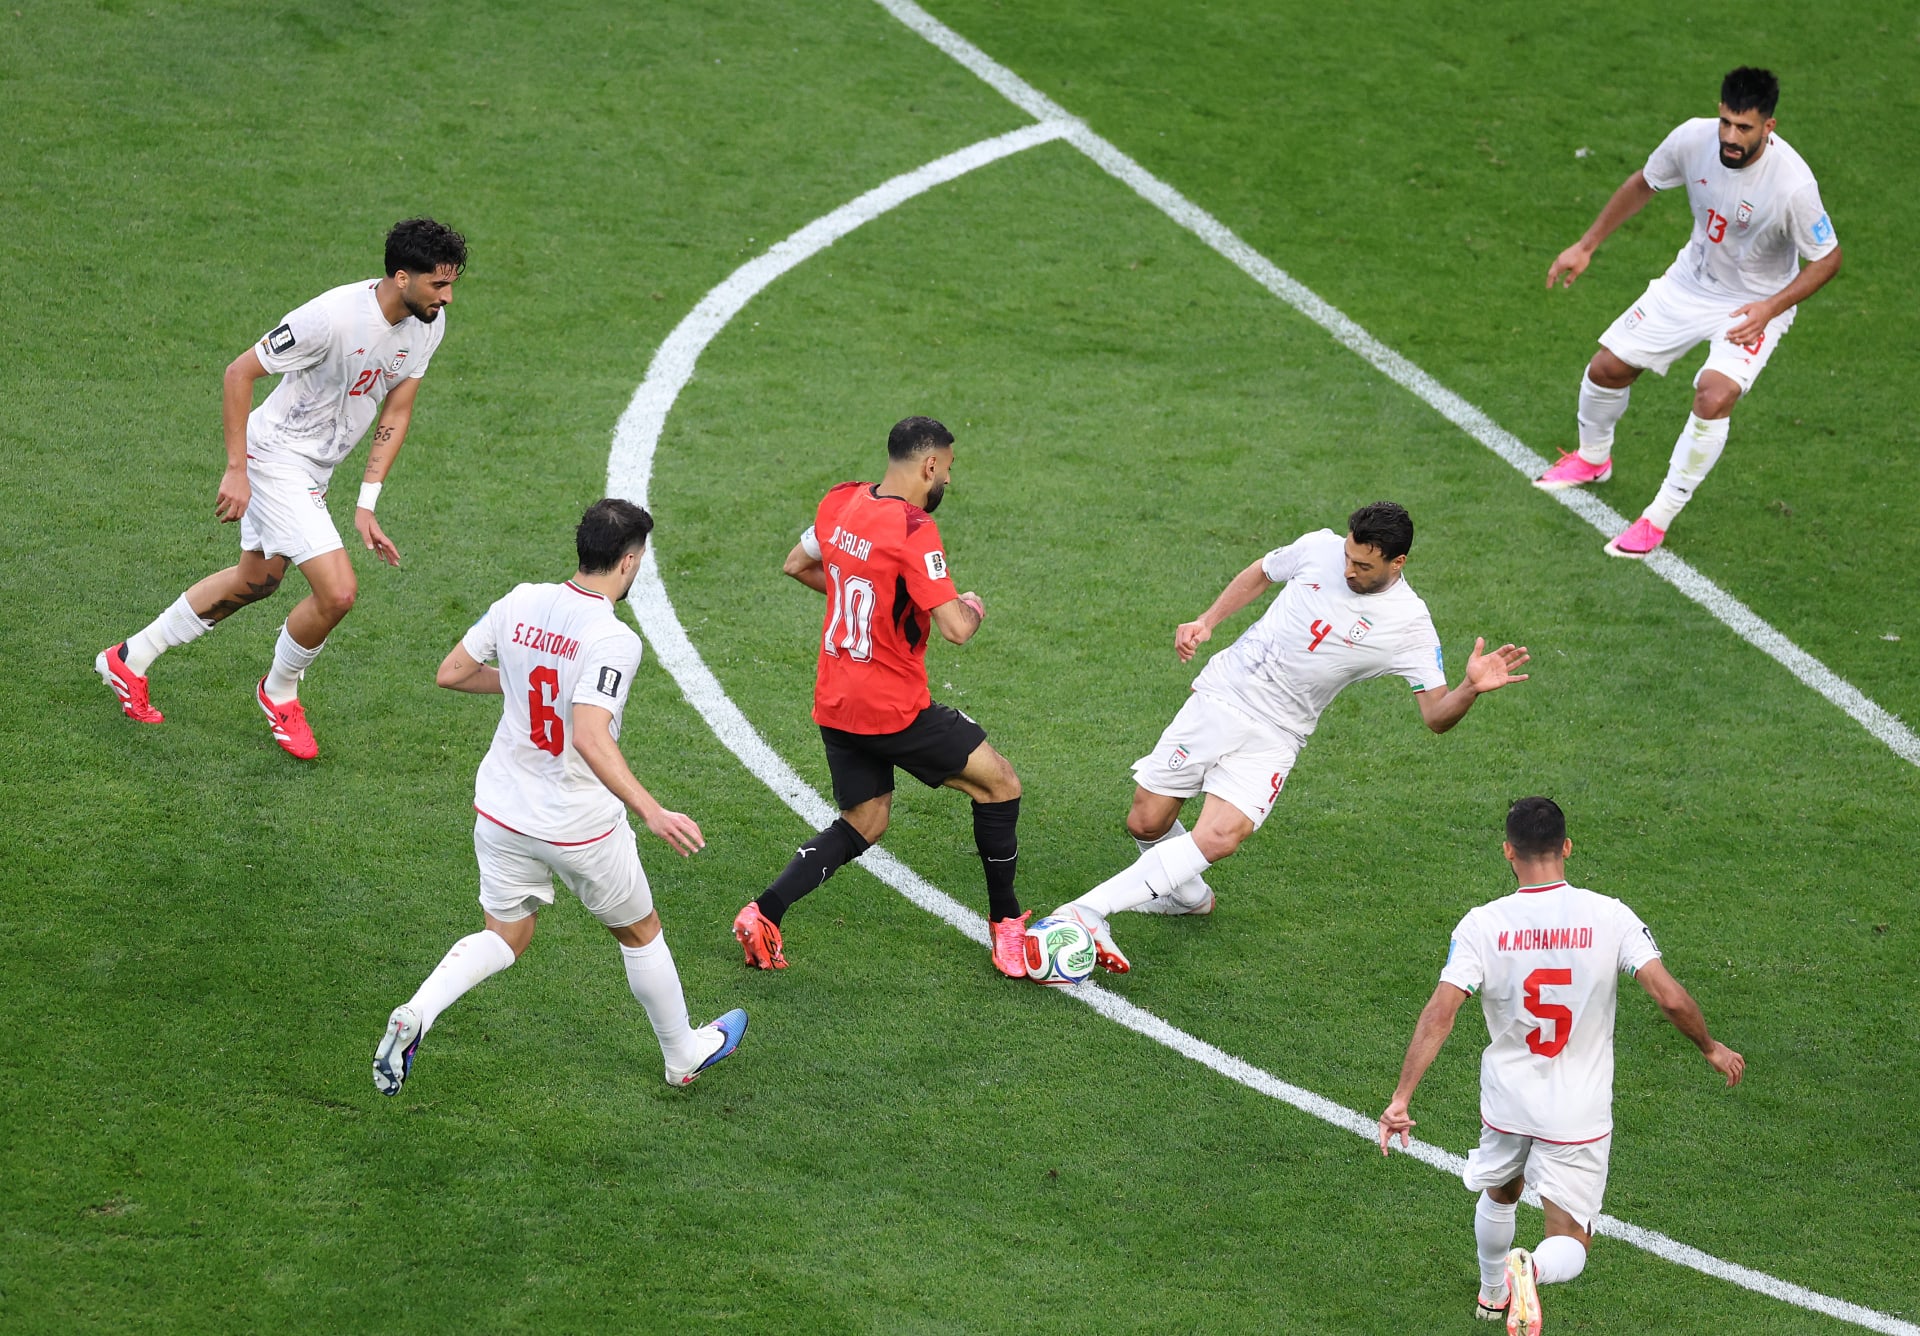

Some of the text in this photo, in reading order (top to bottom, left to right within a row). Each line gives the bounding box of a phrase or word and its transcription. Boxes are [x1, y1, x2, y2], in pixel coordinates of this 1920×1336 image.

[1705, 208, 1728, 244] 13
[349, 369, 381, 396] 21
[824, 563, 876, 663] 10
[1307, 619, 1332, 652] 4
[528, 665, 565, 757] 6
[1498, 927, 1593, 951] M.MOHAMMADI
[1523, 968, 1573, 1059] 5
